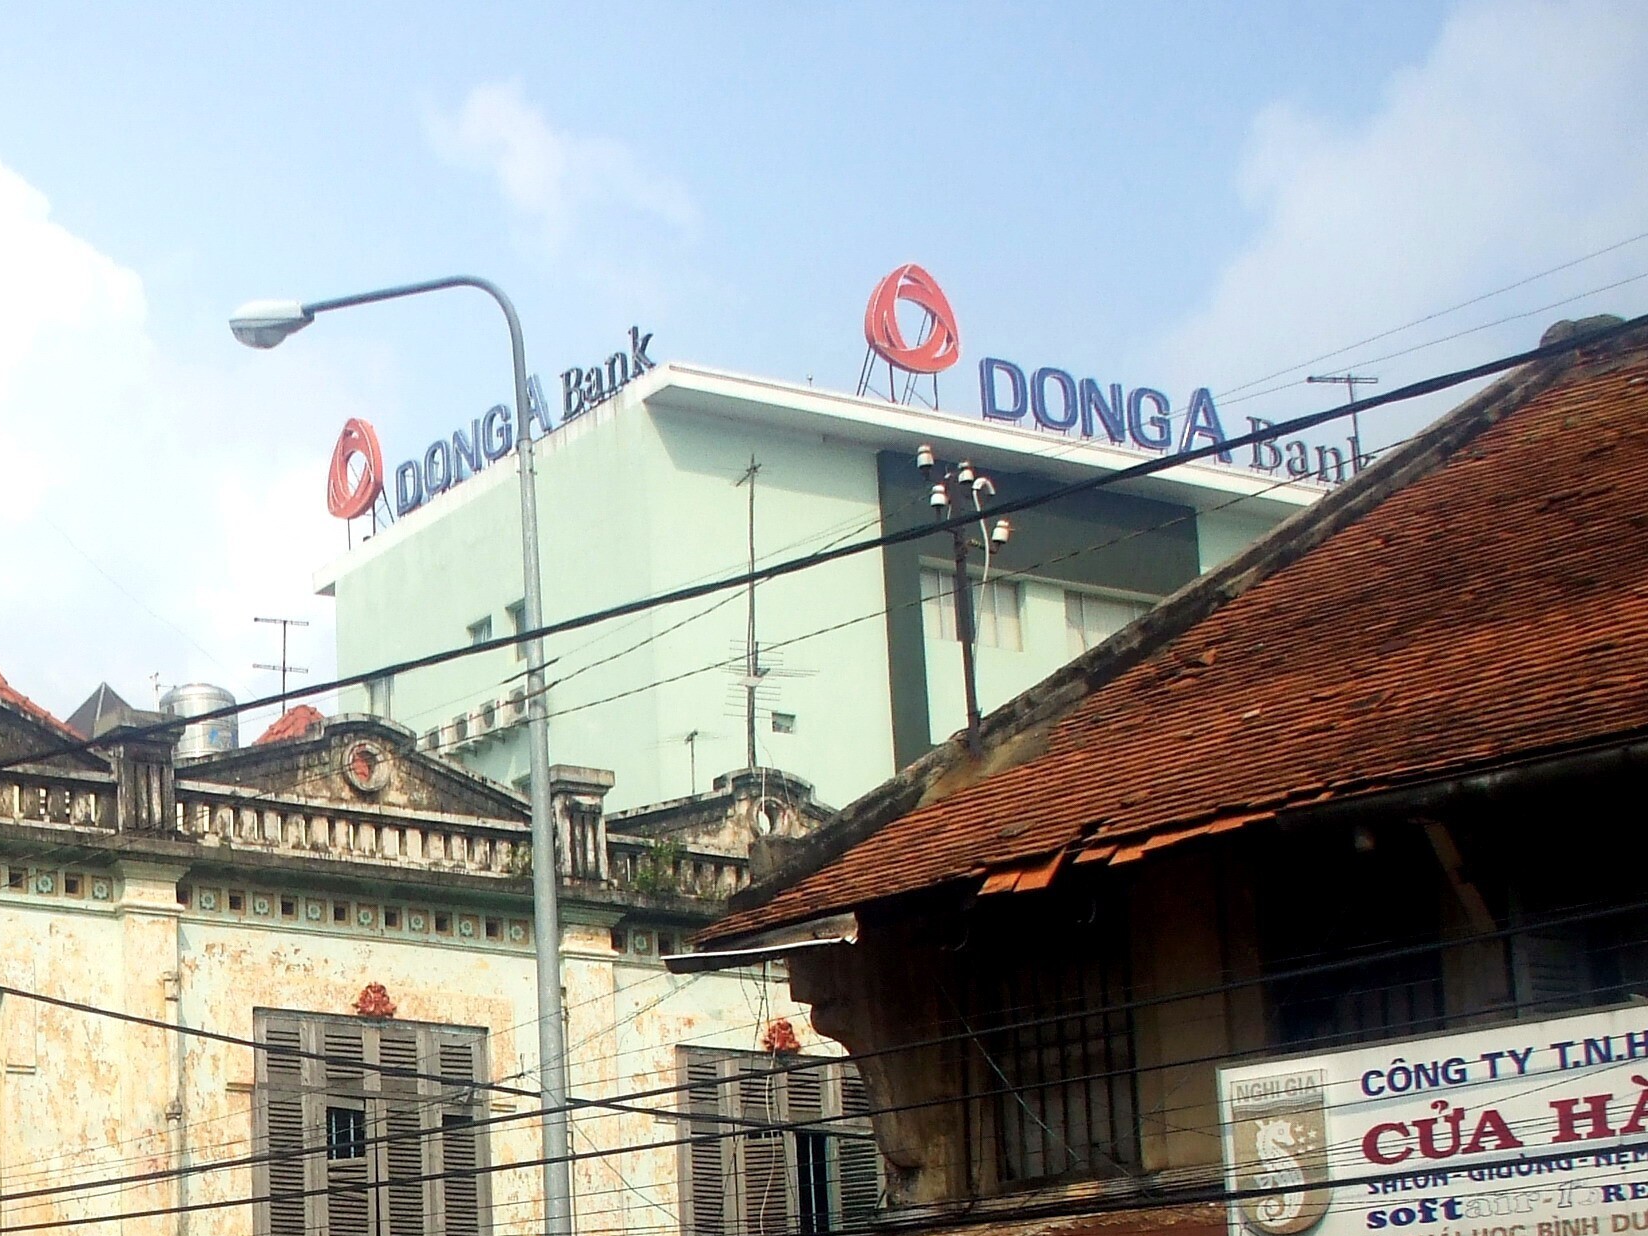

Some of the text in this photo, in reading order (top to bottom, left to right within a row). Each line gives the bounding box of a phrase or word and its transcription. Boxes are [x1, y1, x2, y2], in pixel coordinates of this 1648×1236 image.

[560, 326, 656, 421] Bank
[1236, 1075, 1318, 1103] NGHI GIA
[1361, 1058, 1467, 1097] CÔNG
[1481, 1046, 1534, 1079] TY
[1362, 1099, 1523, 1165] CỬA
